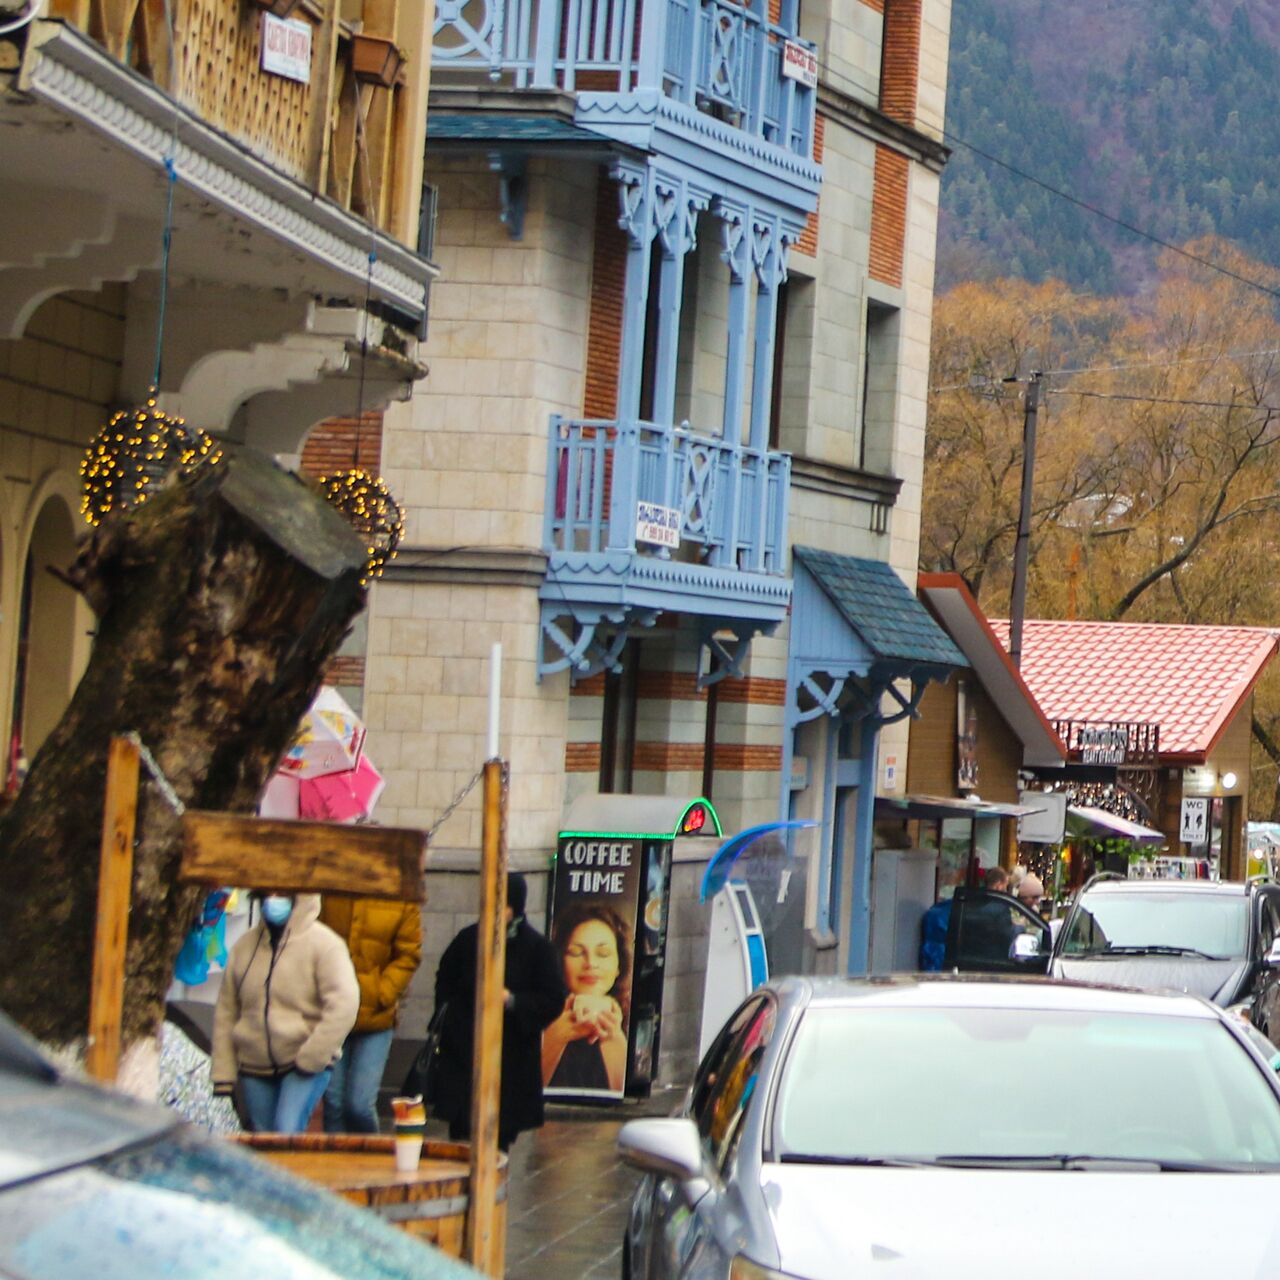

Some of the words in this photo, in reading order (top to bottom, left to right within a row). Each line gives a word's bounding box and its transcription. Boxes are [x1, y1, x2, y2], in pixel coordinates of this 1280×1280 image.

[1186, 801, 1203, 809] WC
[564, 841, 633, 867] COFFEE
[569, 870, 625, 893] TIME
